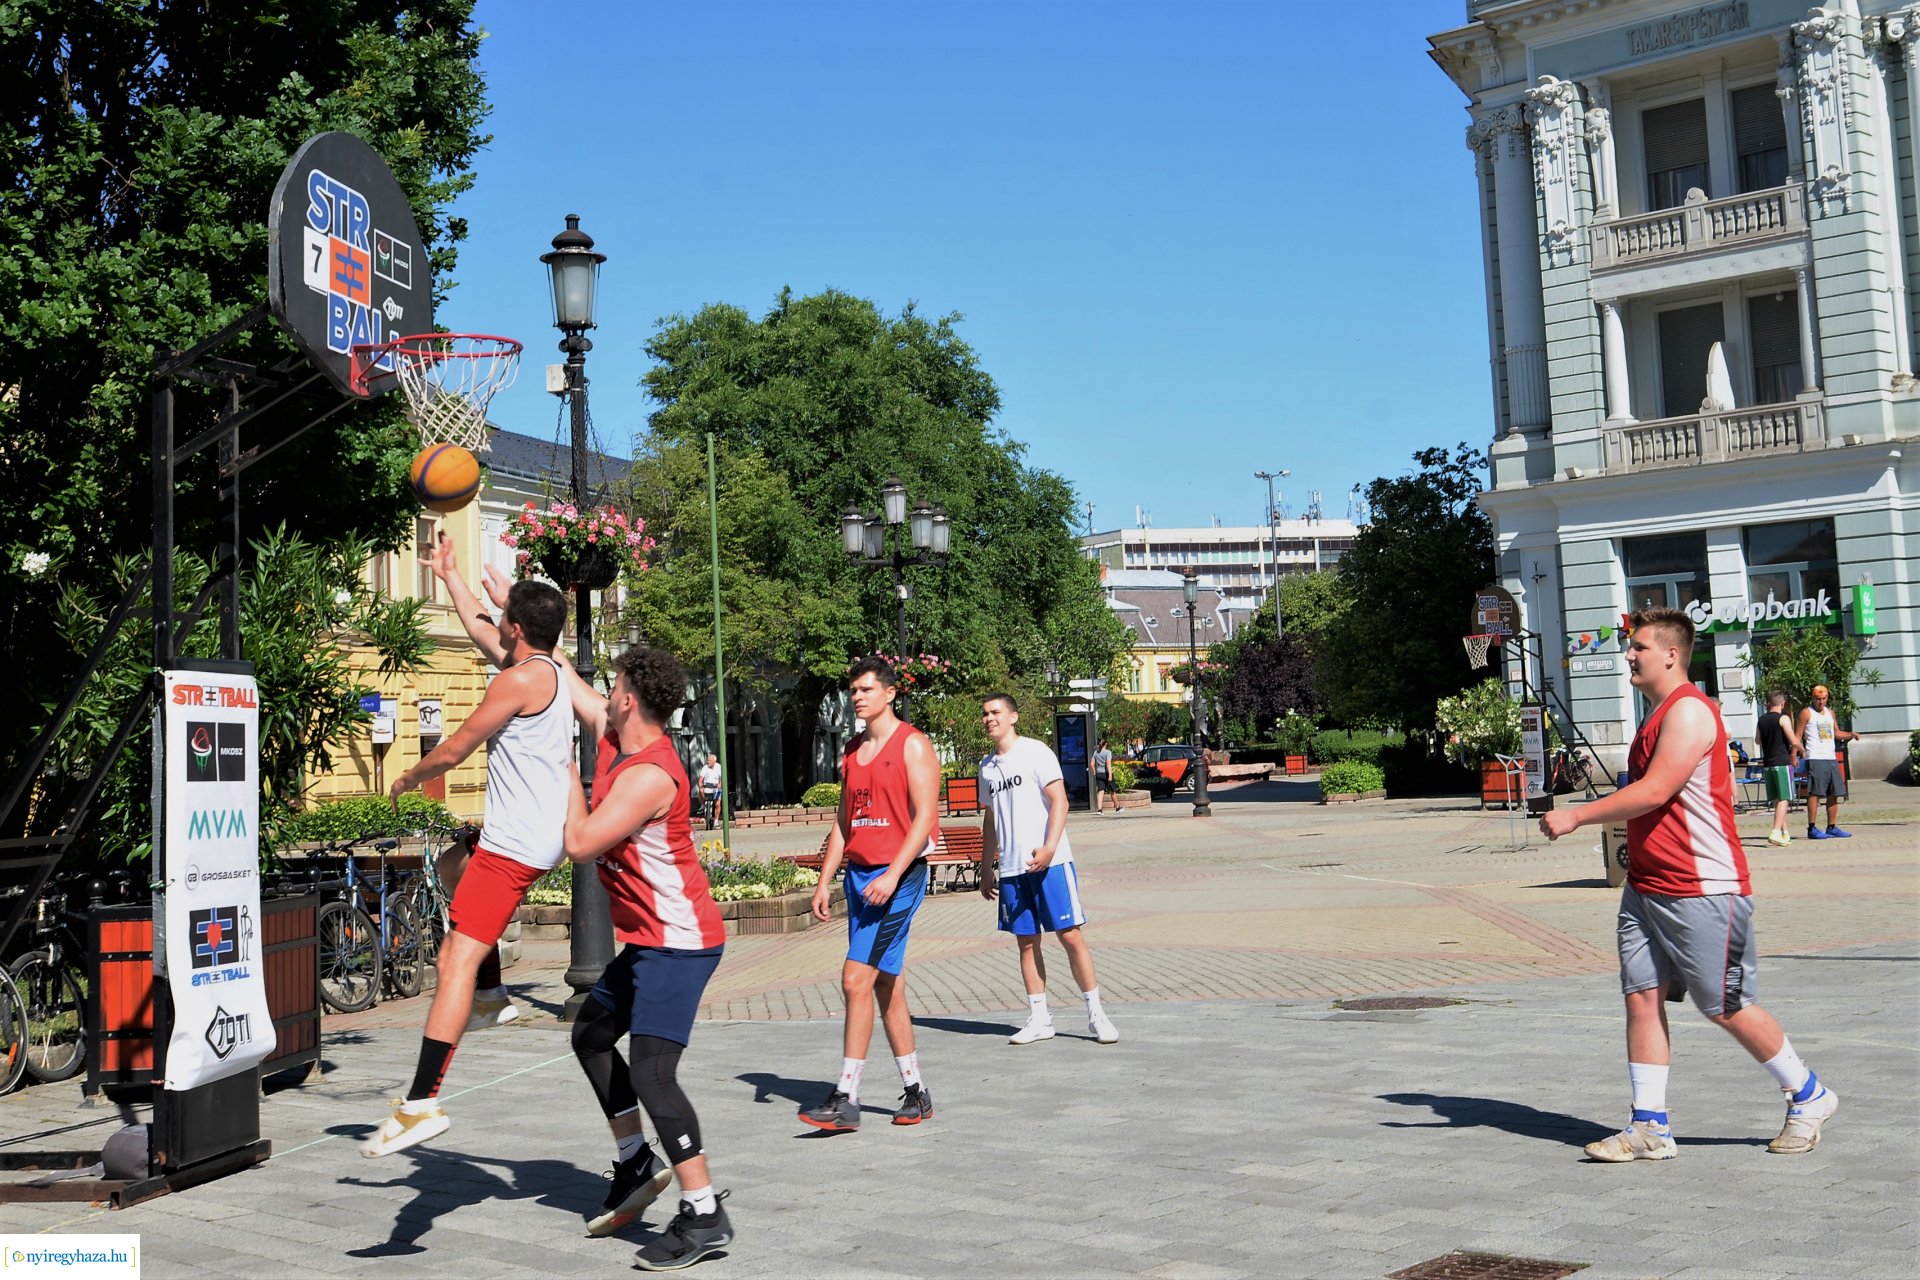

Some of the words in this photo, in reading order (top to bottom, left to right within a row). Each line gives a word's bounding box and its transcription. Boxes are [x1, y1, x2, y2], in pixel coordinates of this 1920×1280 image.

[306, 169, 370, 252] STR
[311, 243, 323, 273] 7
[997, 775, 1022, 792] JAKO
[188, 809, 247, 840] MVM
[201, 869, 251, 881] GROSBASKET
